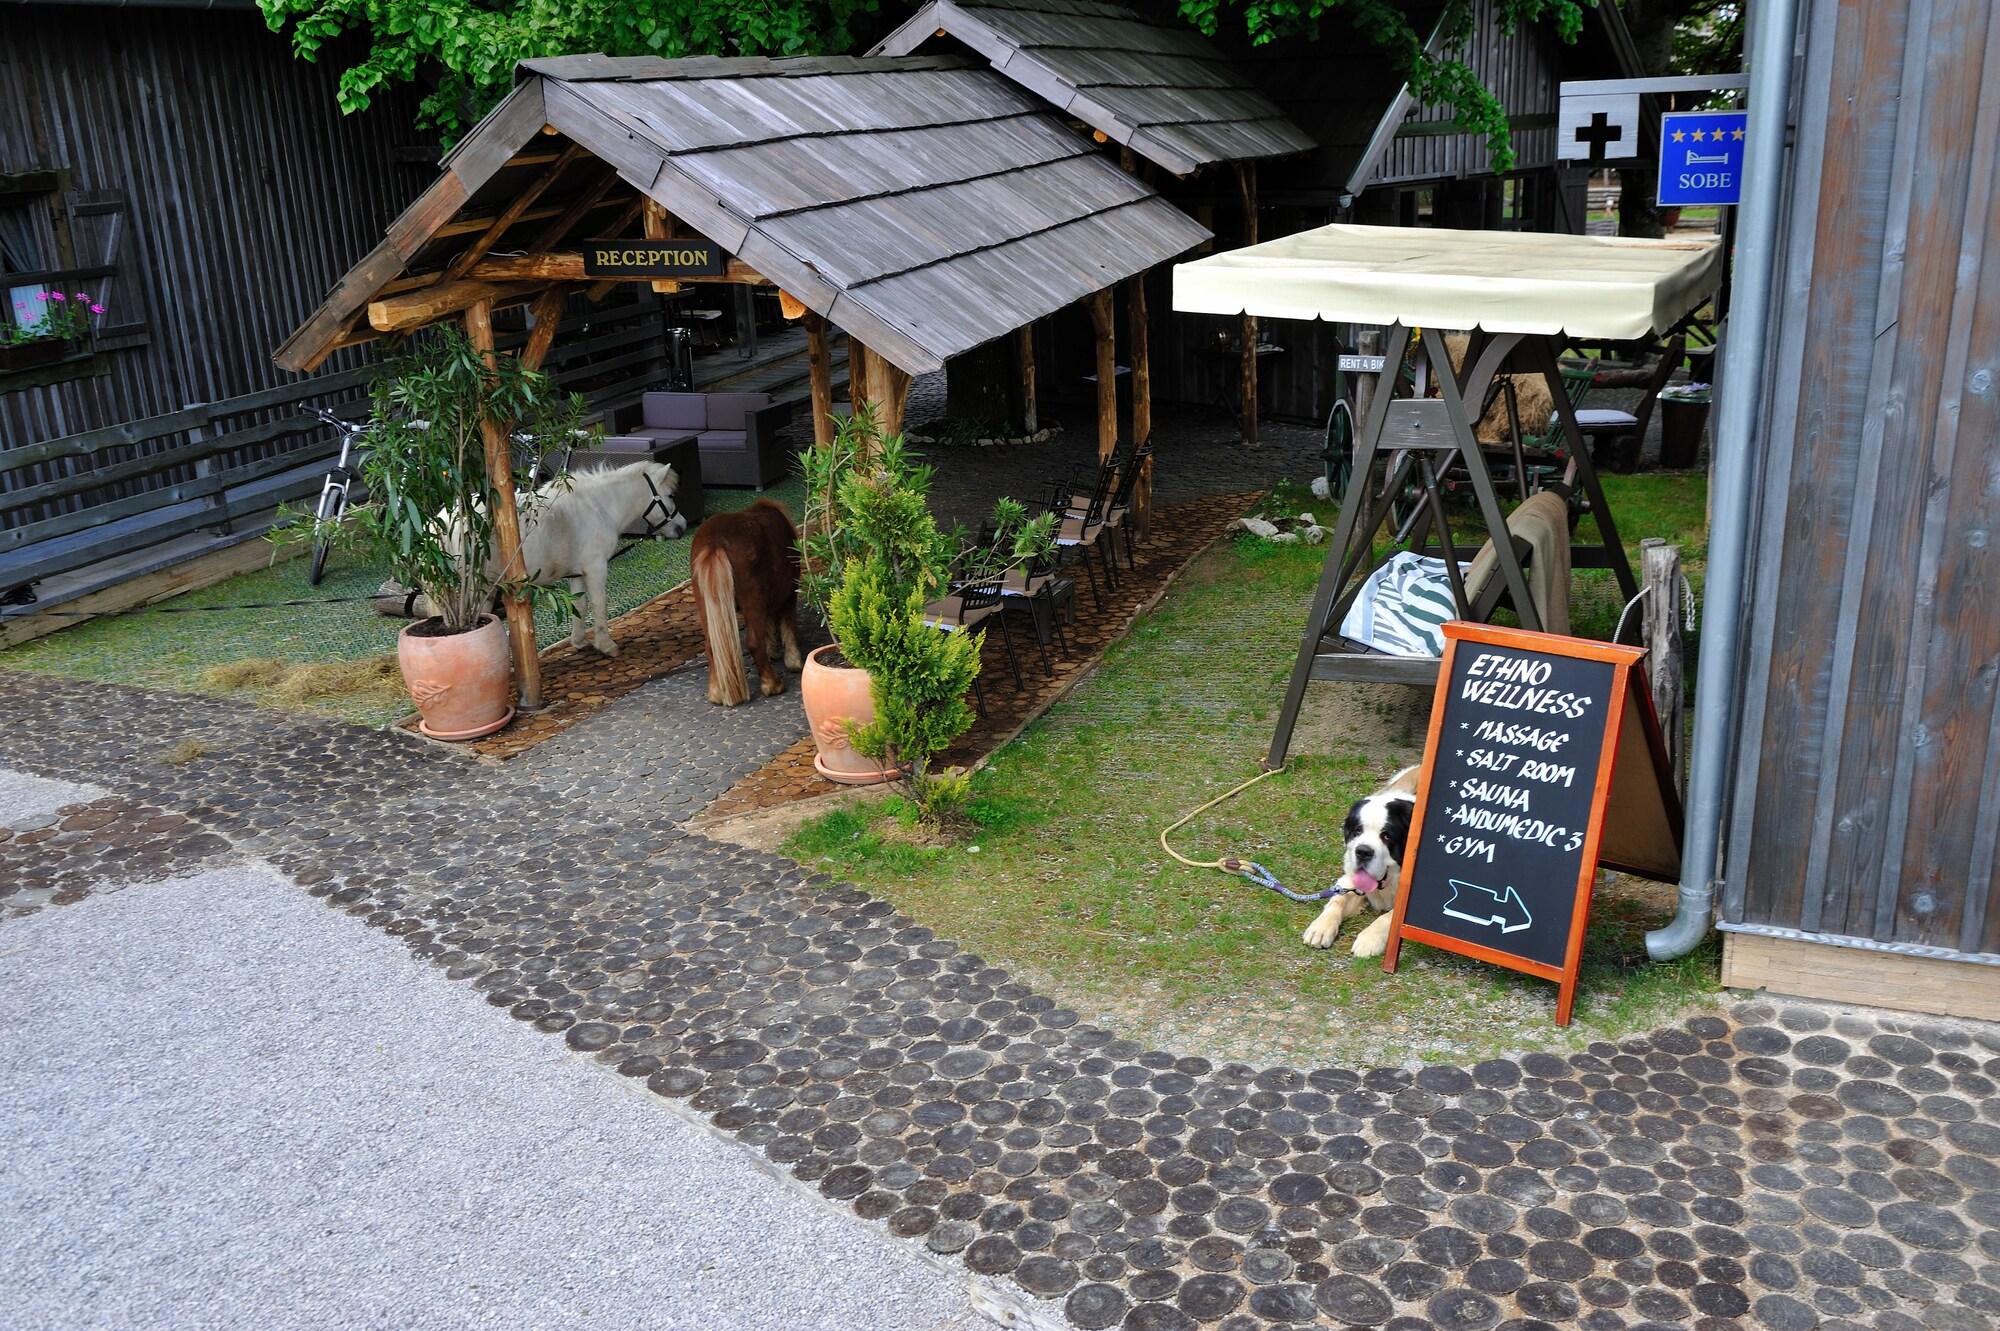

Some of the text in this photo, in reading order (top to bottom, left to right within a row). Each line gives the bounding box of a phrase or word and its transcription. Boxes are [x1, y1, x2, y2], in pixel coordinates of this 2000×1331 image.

[1679, 173, 1731, 189] SOBE
[596, 250, 708, 266] RECEPTION
[1340, 358, 1384, 369] RENT A BIK
[1467, 653, 1552, 685] ETHNO
[1461, 679, 1592, 719] WELLNESS
[1473, 720, 1570, 752] MASSAGE
[1466, 749, 1576, 788] SALT ROOM
[1459, 778, 1530, 812] SAUNA
[1450, 804, 1584, 852] ANDUMEDIC 3
[1444, 836, 1496, 863] GYM
